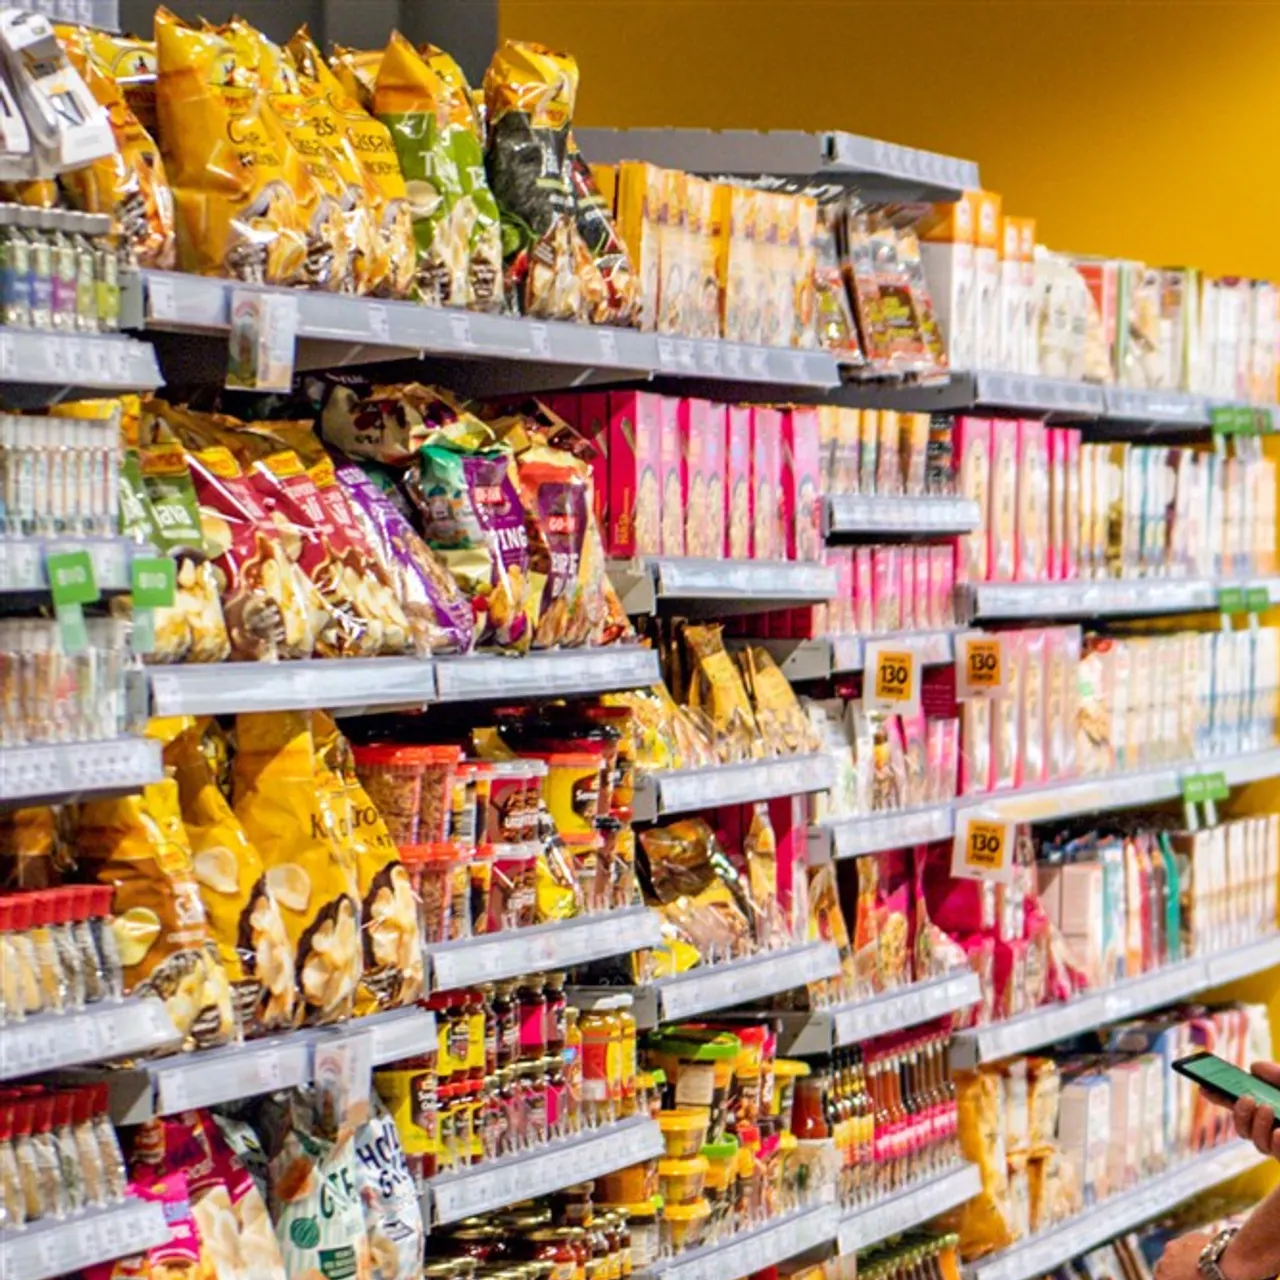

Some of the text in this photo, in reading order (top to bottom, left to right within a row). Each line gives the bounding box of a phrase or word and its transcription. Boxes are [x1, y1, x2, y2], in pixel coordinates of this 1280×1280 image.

[967, 652, 997, 671] 130
[880, 664, 908, 684] 130
[971, 833, 1000, 853] 130
